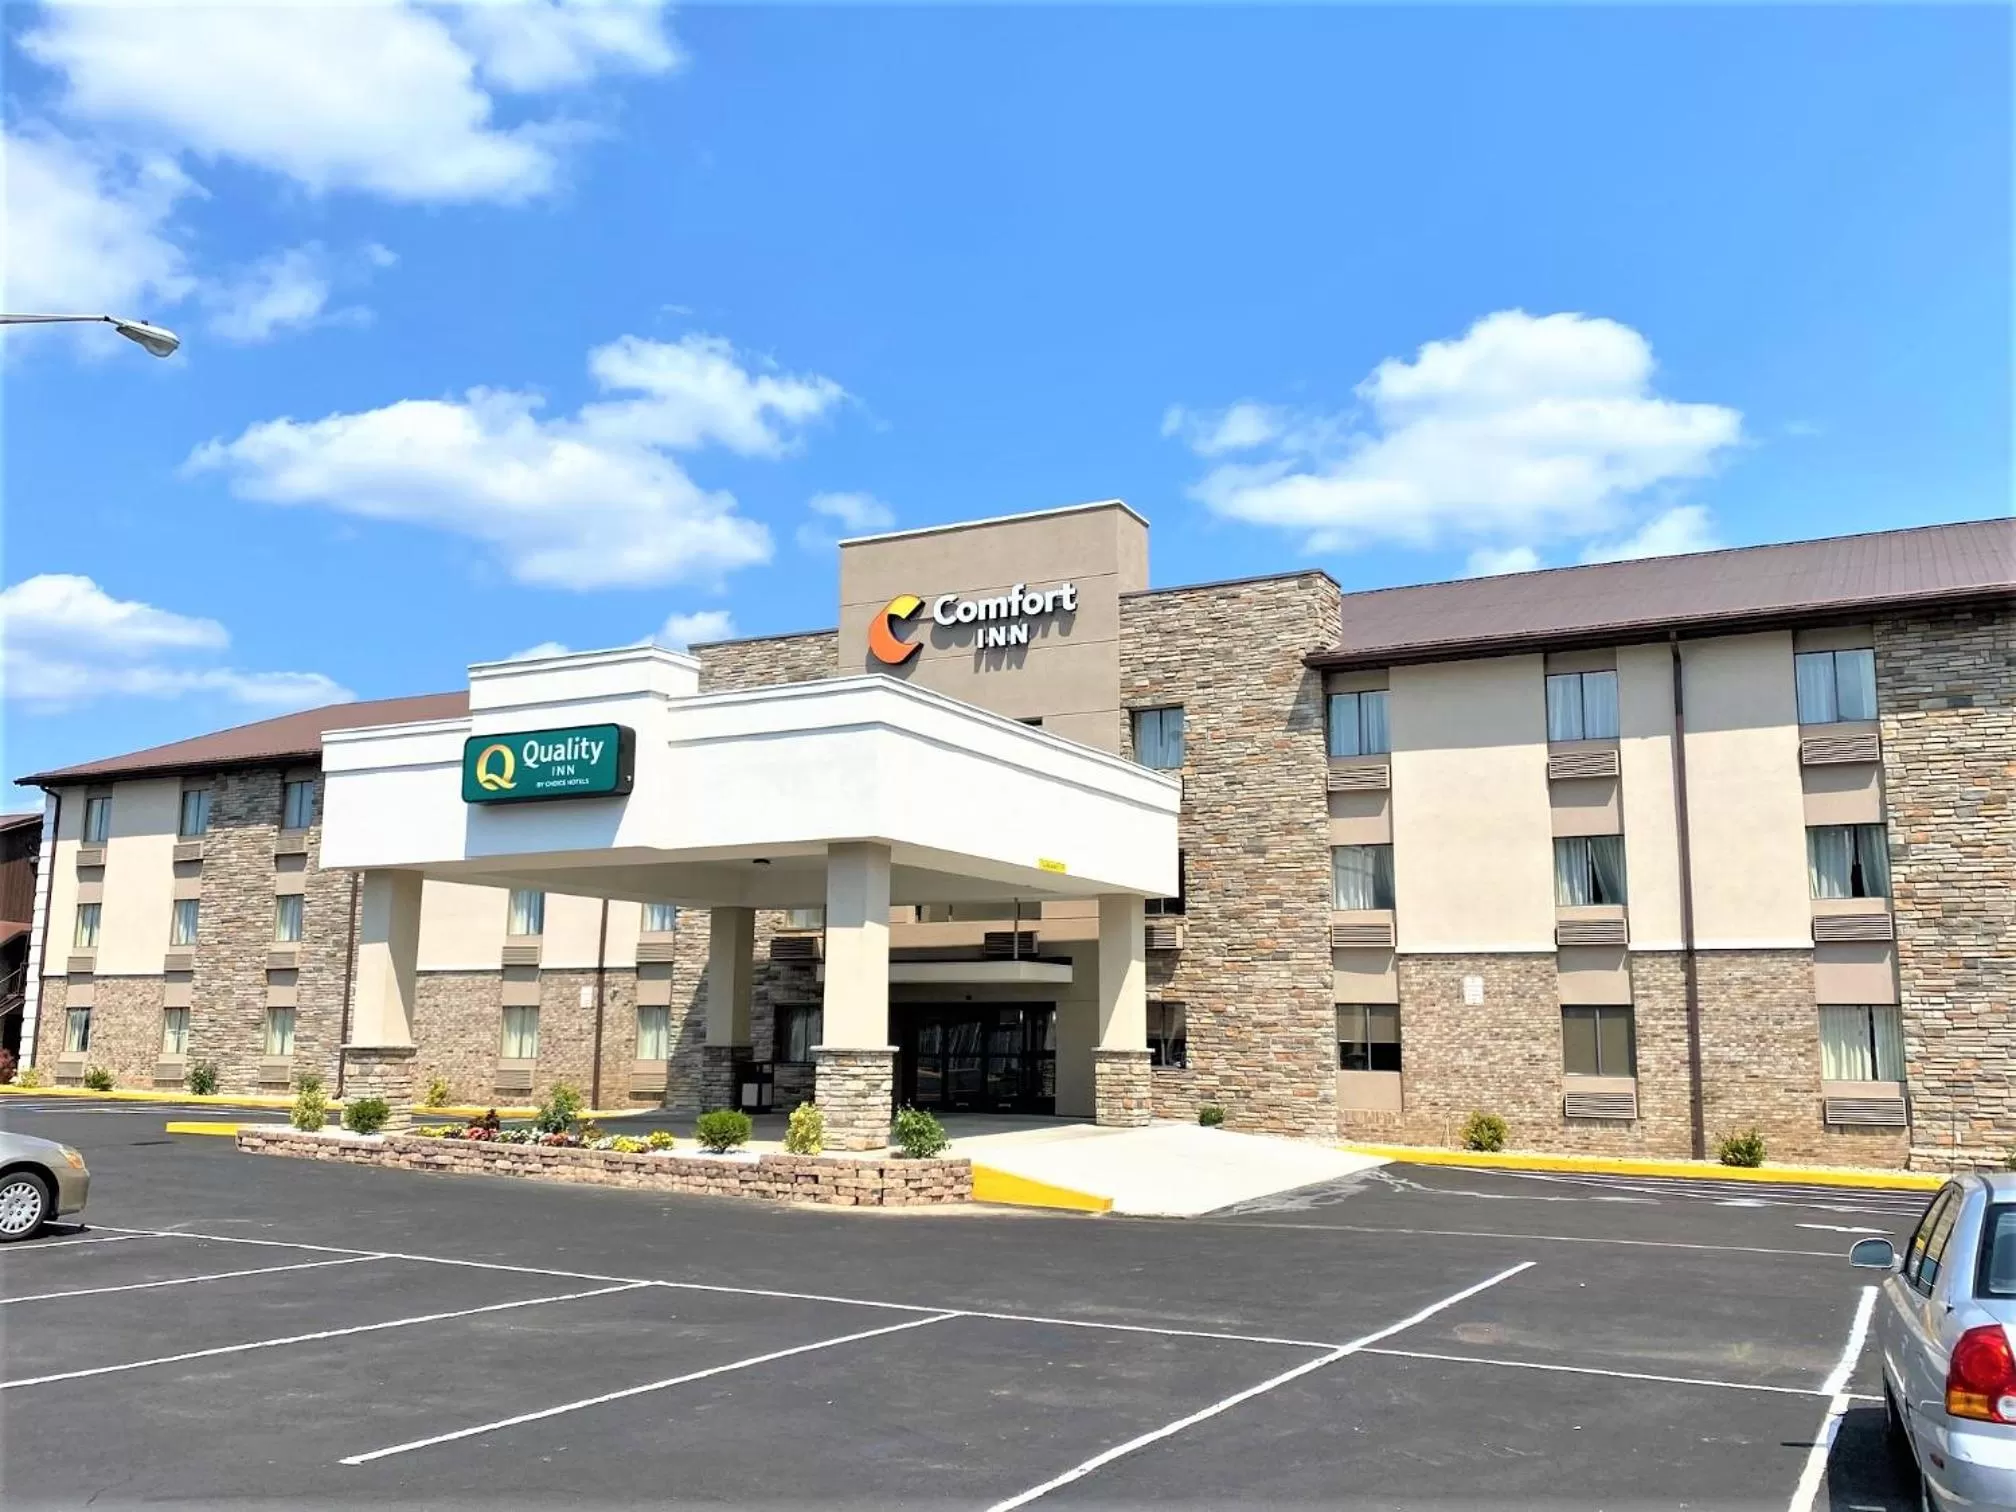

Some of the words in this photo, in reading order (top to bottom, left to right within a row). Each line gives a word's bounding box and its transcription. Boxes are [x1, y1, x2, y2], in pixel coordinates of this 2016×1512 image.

[933, 583, 1076, 626] Comfort
[977, 624, 1028, 648] INN
[476, 743, 517, 791] Q
[522, 736, 604, 768] Quality
[551, 765, 575, 777] INN
